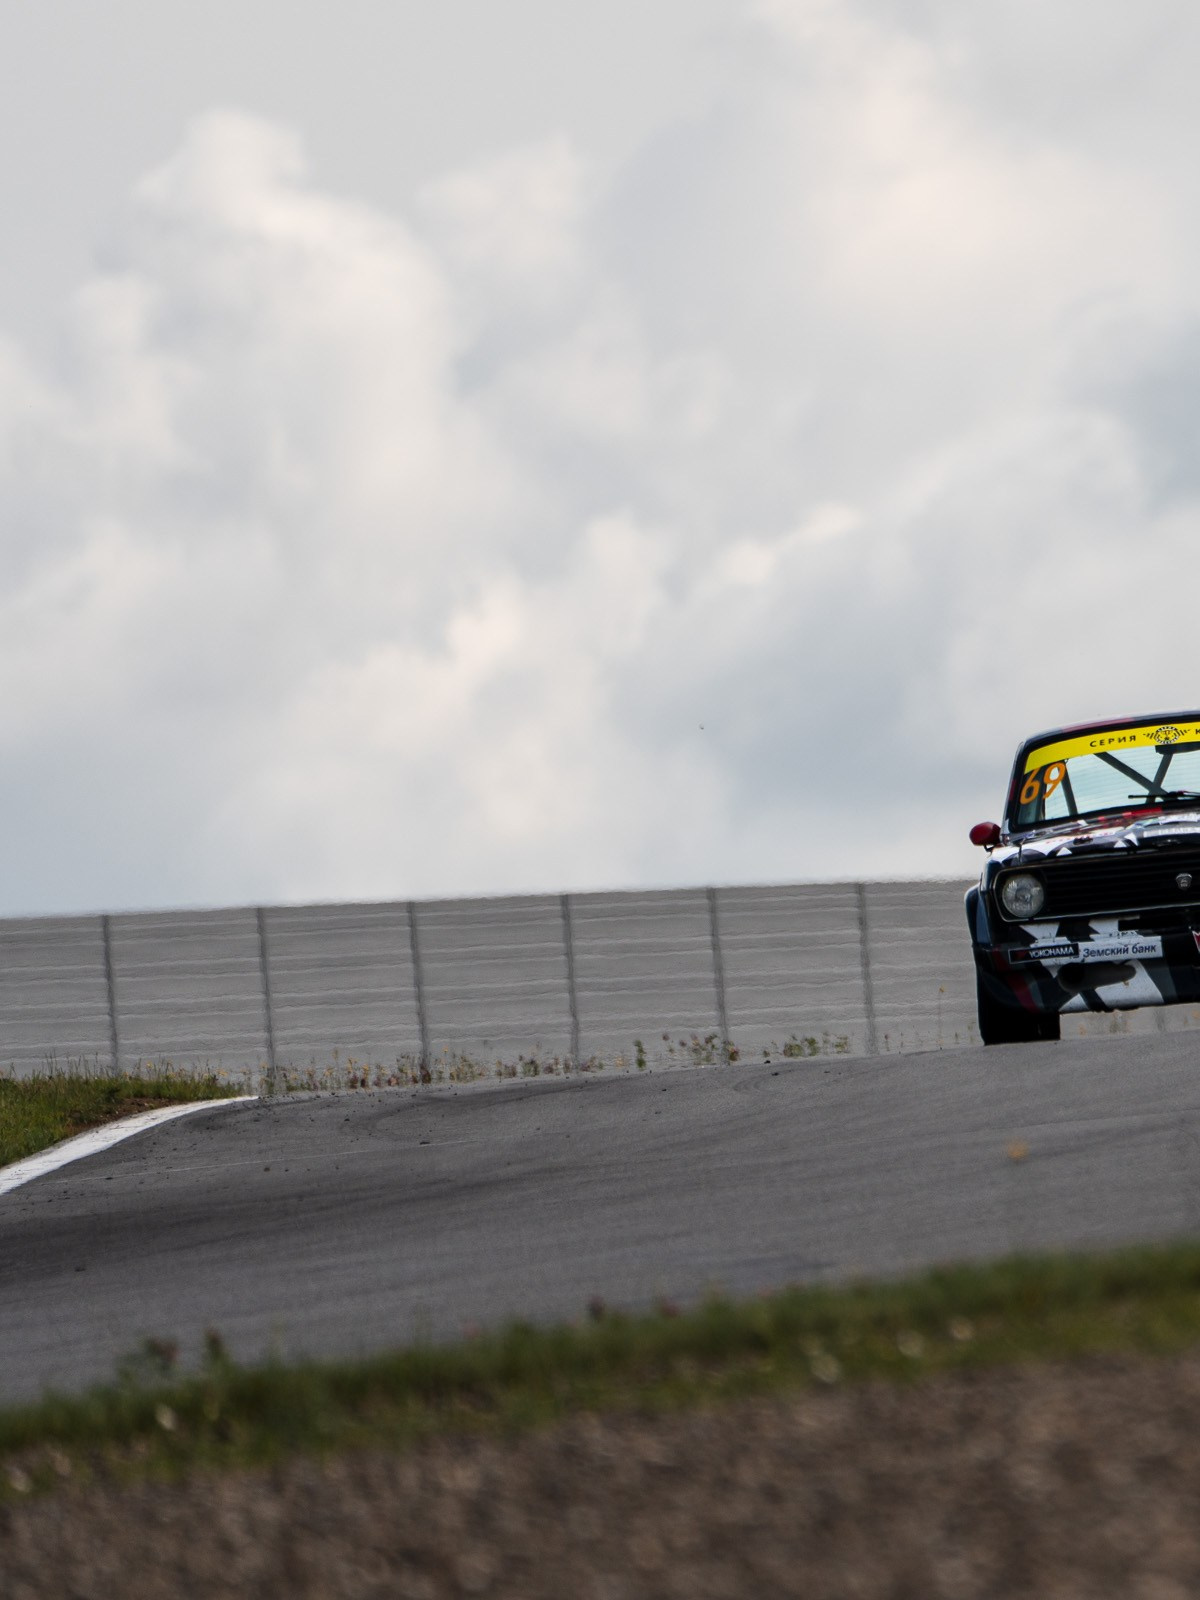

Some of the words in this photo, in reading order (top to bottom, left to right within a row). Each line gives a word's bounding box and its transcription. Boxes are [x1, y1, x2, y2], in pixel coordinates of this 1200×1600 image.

[1089, 735, 1137, 748] СЕРИЯ
[1020, 762, 1066, 805] 69
[1029, 946, 1074, 958] YOKOHAMA
[1083, 945, 1129, 958] Земский
[1131, 943, 1157, 954] банк
